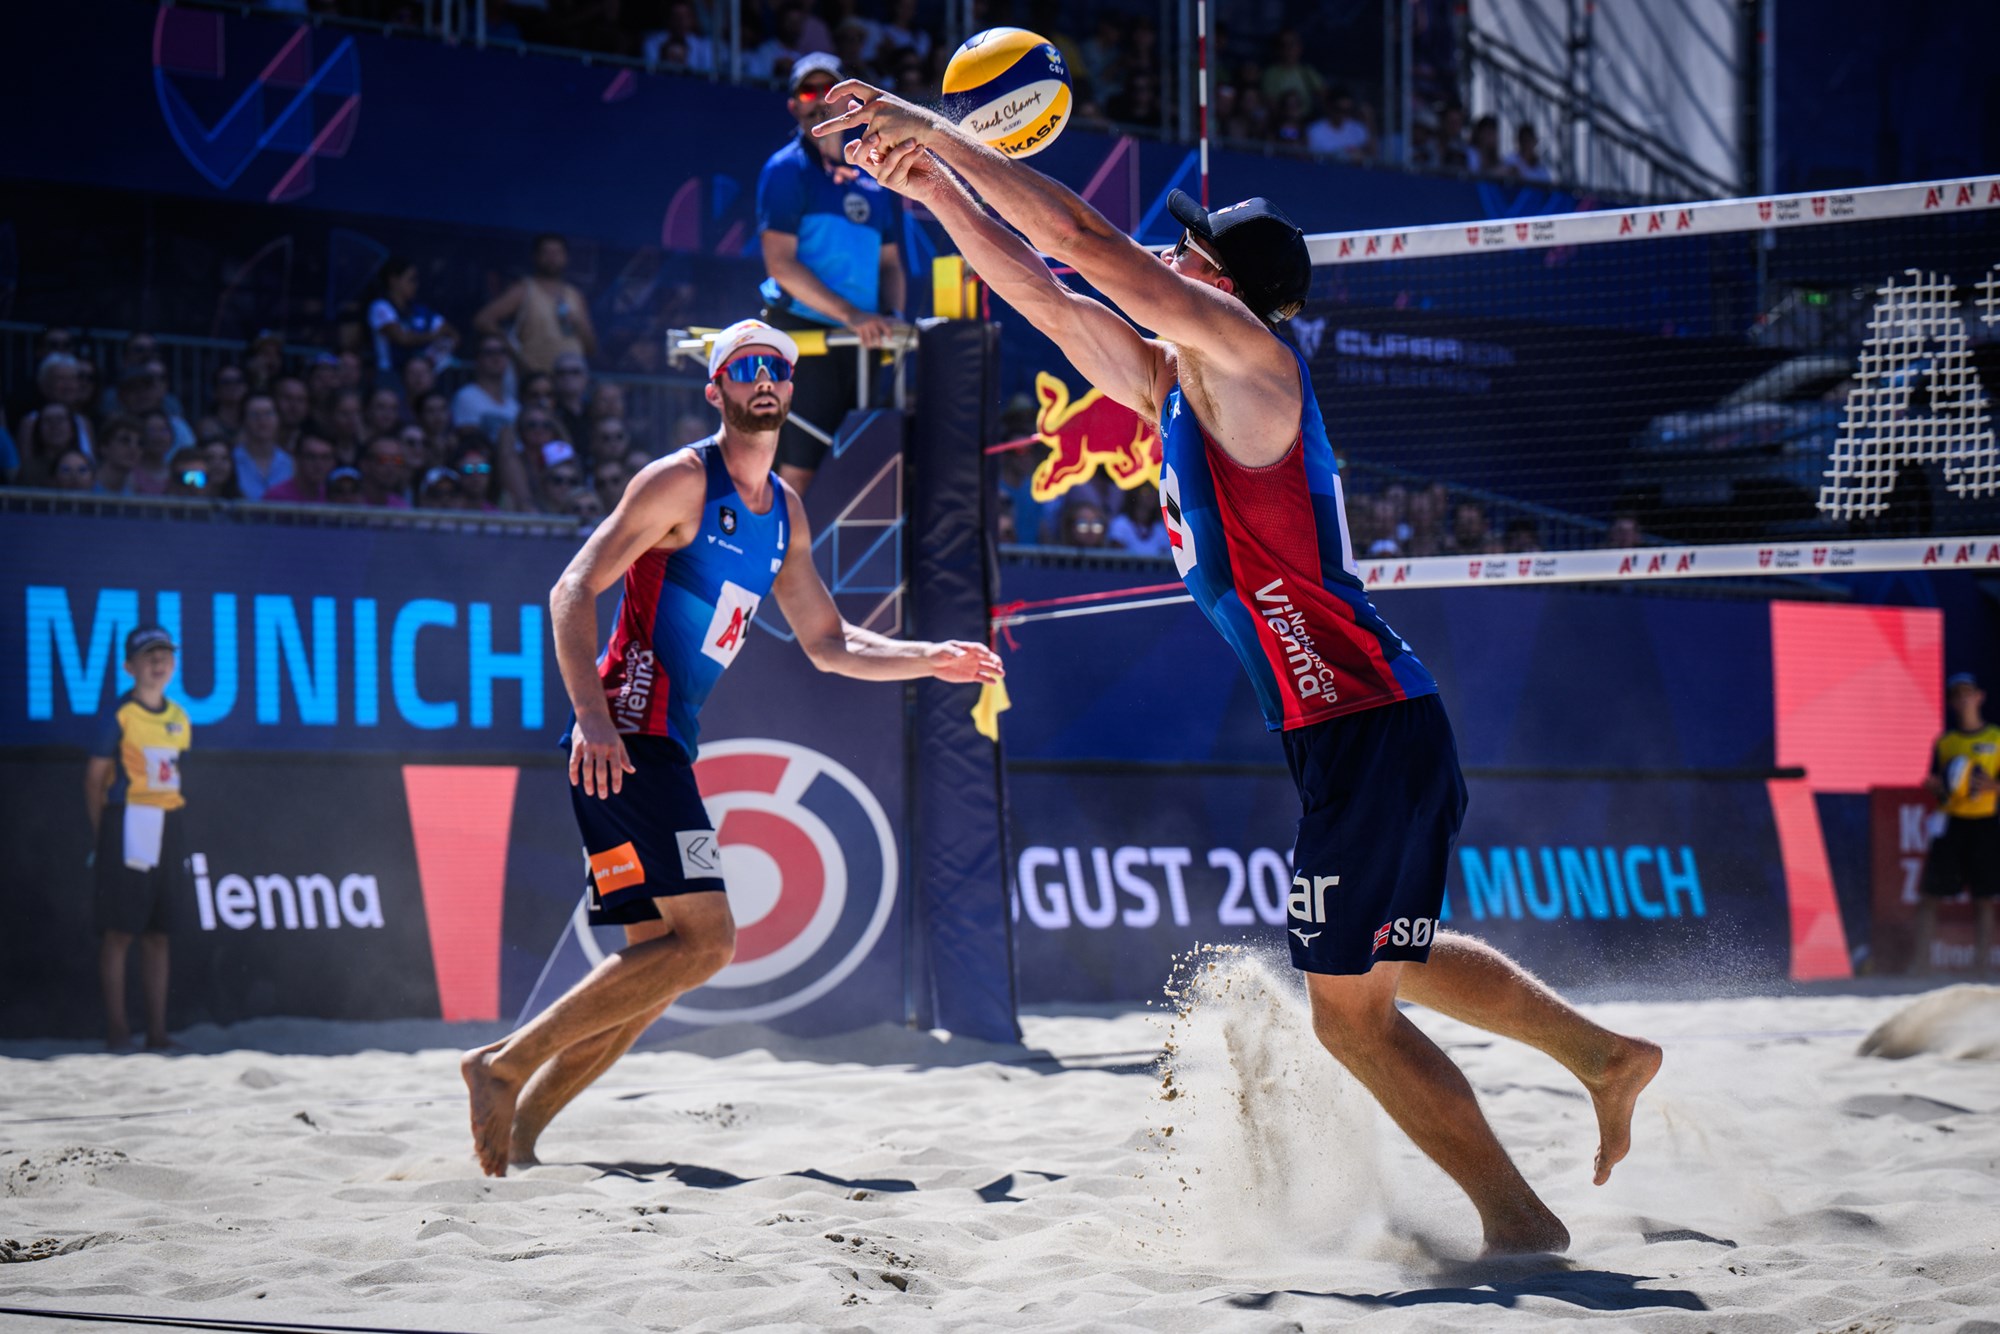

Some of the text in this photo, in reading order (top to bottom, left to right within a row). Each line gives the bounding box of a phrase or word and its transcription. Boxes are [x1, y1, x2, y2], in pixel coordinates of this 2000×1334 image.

[1048, 62, 1065, 76] CEV
[971, 91, 1042, 133] Beach Champ
[26, 585, 544, 729] MUNICH
[715, 606, 753, 651] A1
[1255, 578, 1321, 699] Vienna
[1288, 611, 1338, 703] NationsCup
[616, 650, 654, 734] Vienna
[190, 853, 385, 931] ienna
[1012, 846, 1192, 930] GUST
[1207, 847, 1295, 926] 20
[1459, 845, 1707, 922] MUNICH
